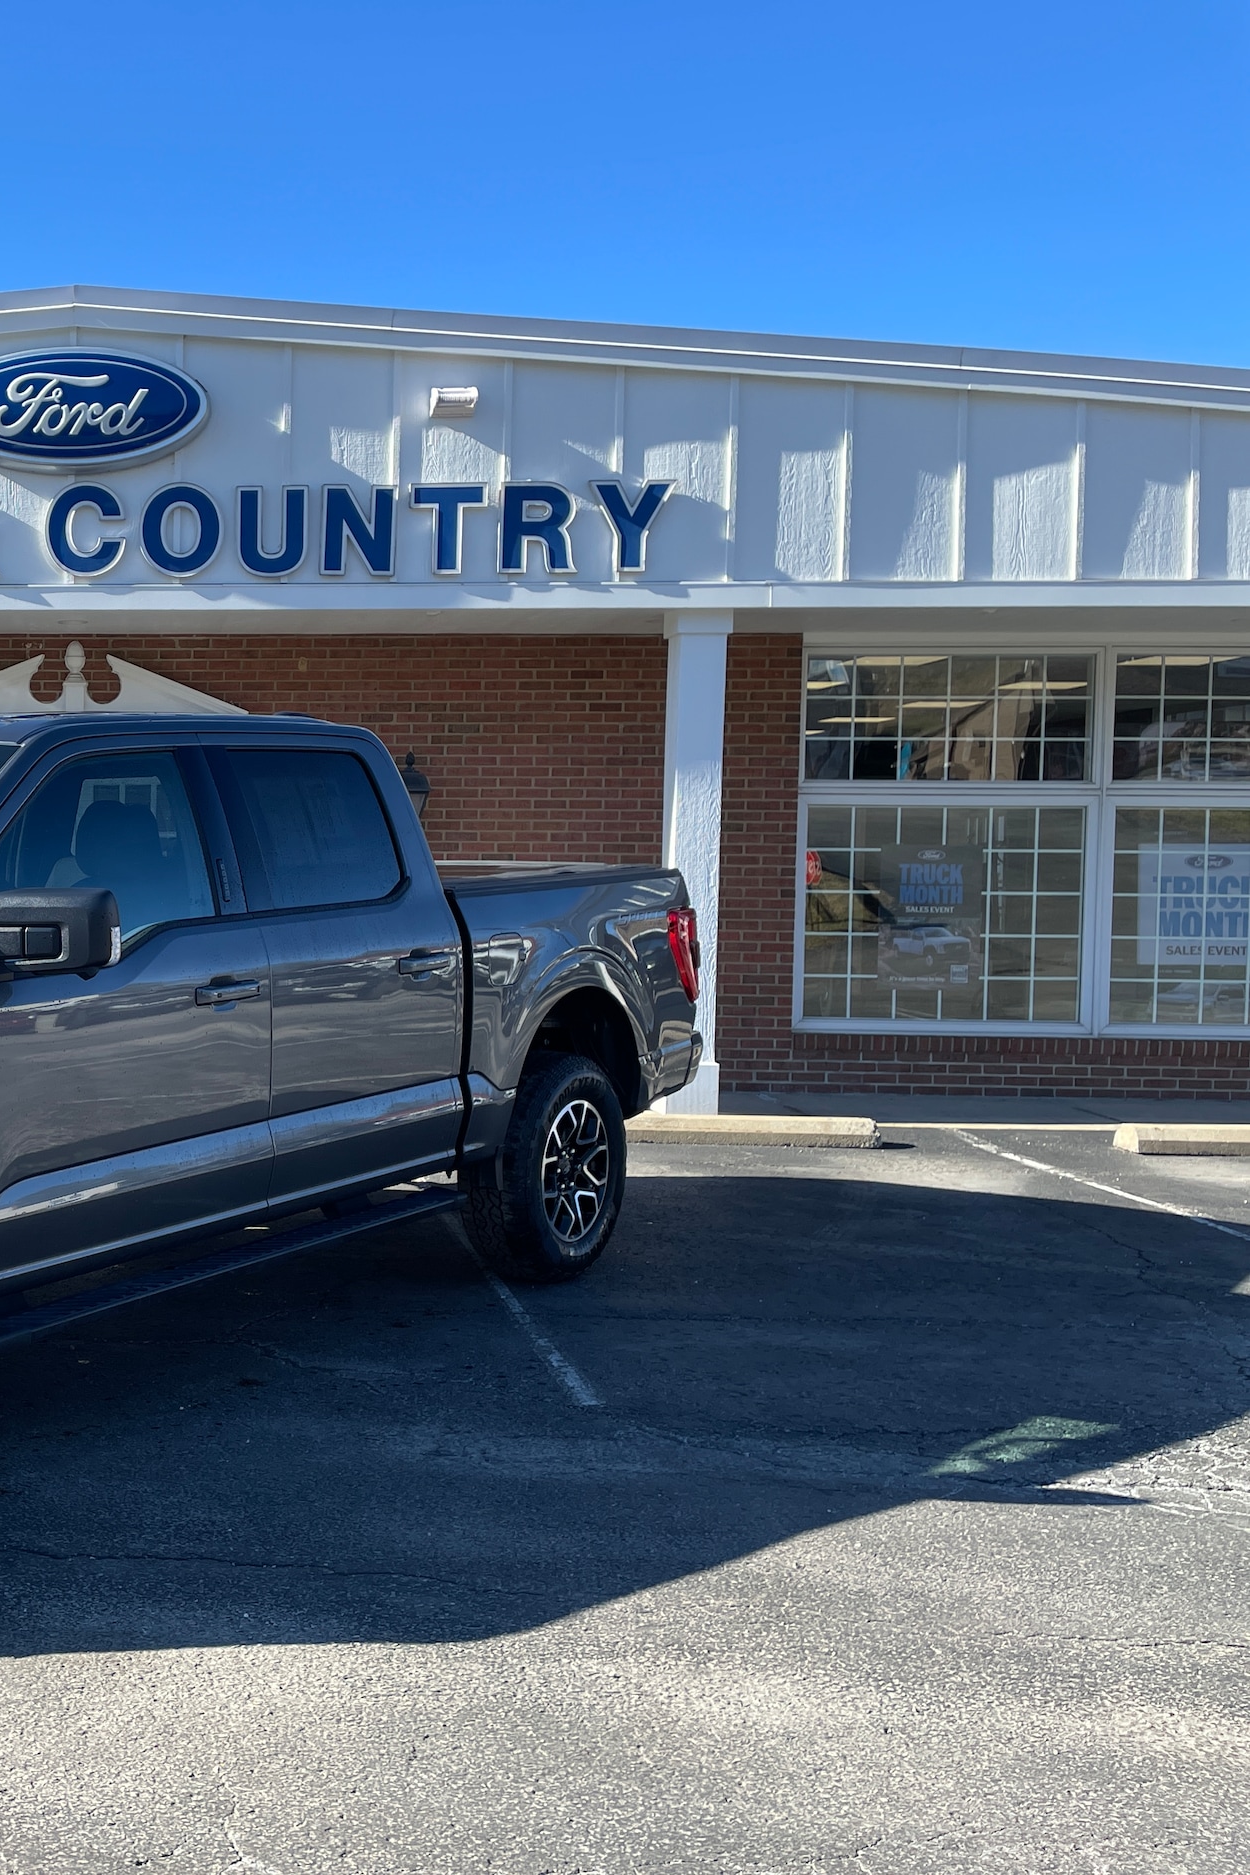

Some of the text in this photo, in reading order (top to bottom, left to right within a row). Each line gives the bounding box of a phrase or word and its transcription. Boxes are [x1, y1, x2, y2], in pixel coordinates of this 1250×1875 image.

[45, 480, 677, 577] COUNTRY
[899, 863, 964, 884] TRUCK
[899, 885, 964, 905] MONTH
[905, 905, 955, 913] SALES EVENT
[1165, 945, 1248, 956] SALES EVENT
